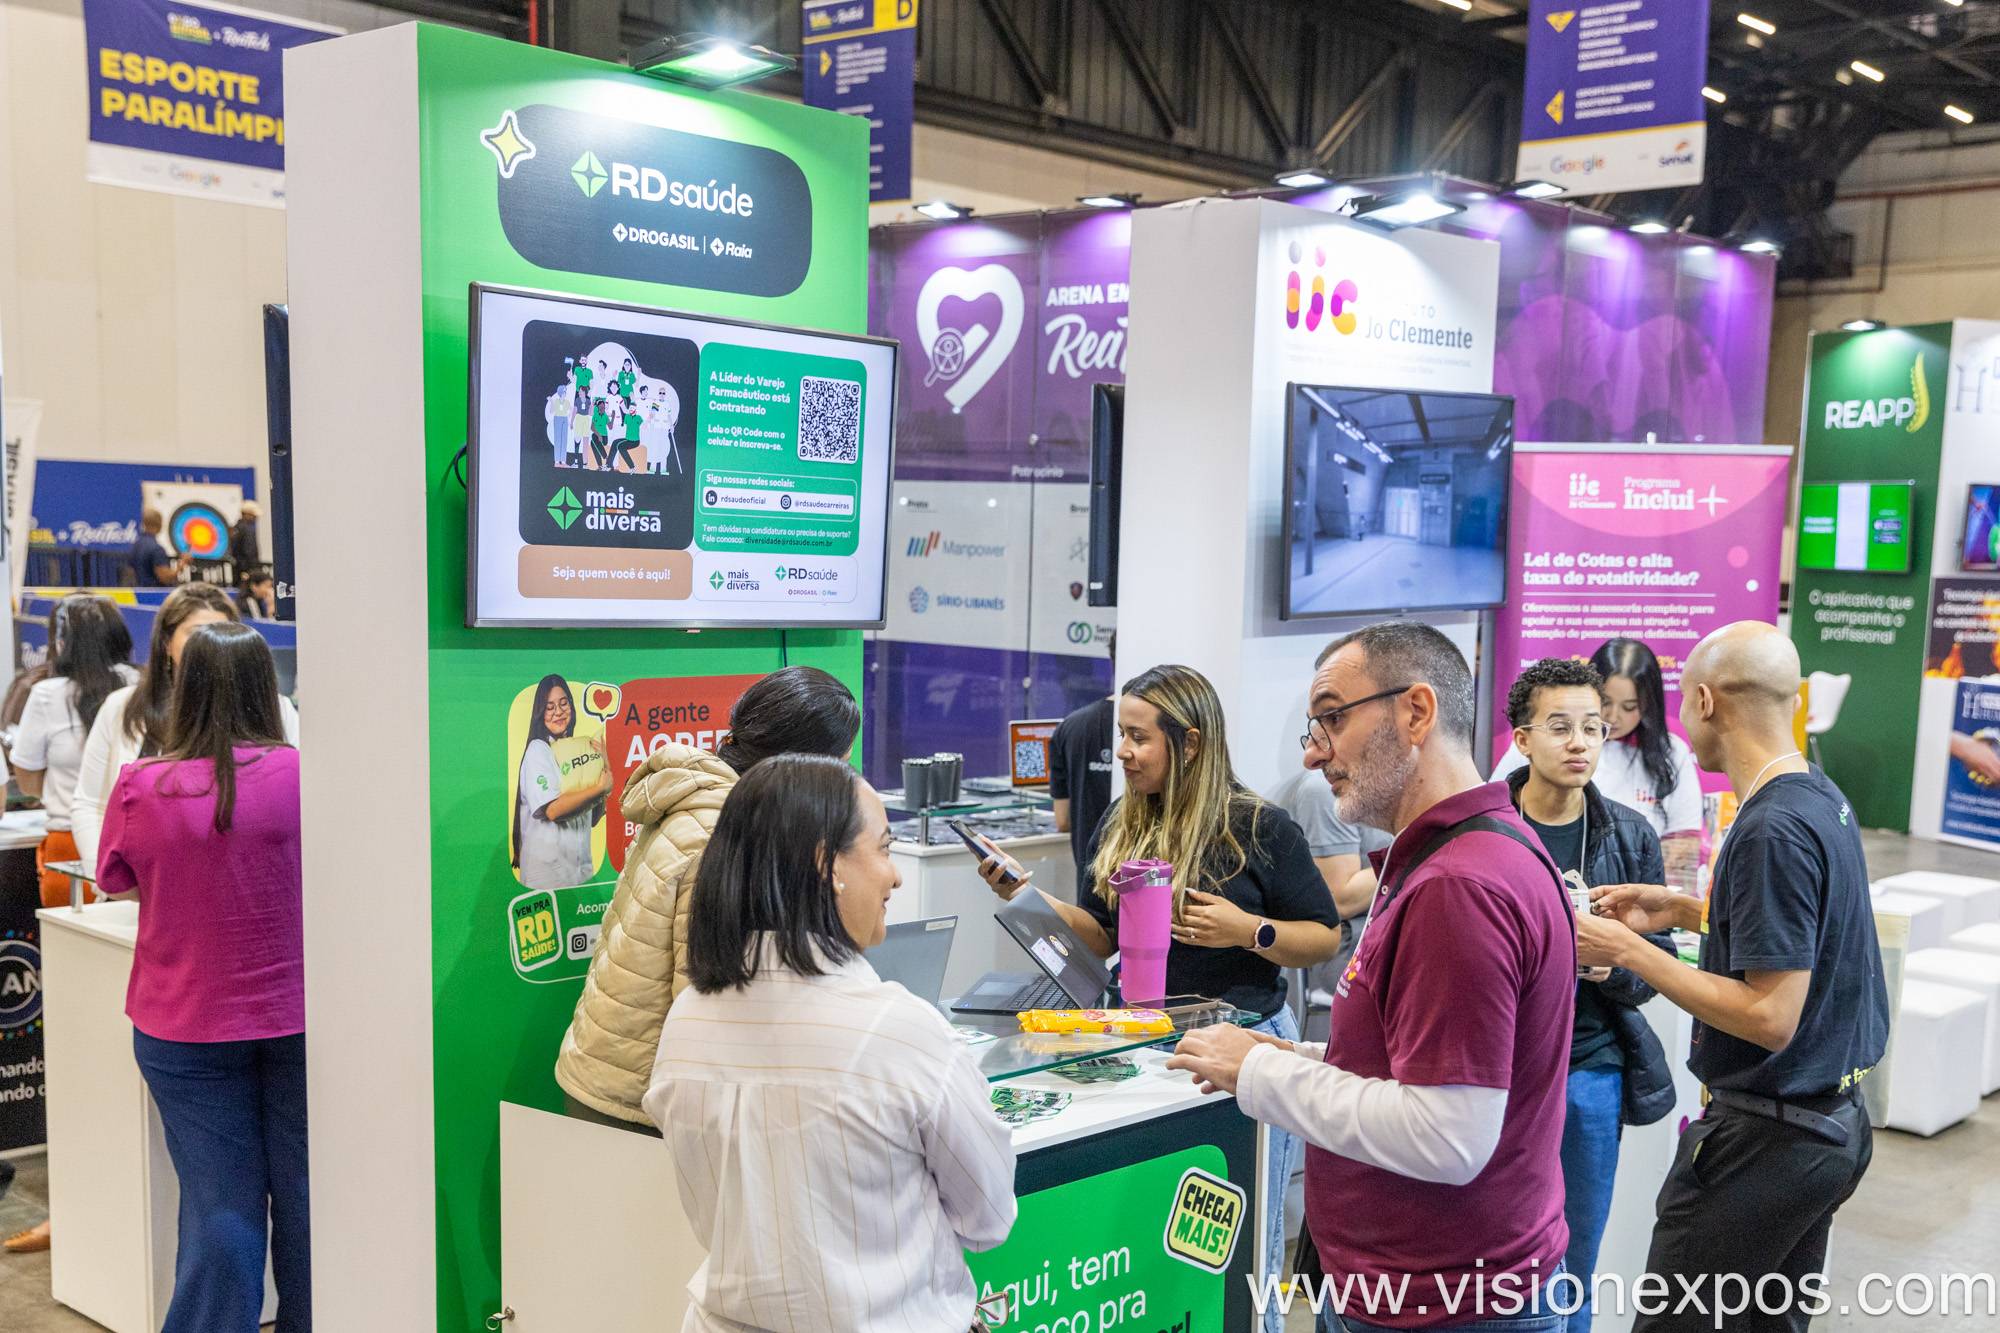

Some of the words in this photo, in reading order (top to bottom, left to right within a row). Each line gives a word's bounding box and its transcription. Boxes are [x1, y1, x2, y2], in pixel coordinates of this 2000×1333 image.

[897, 0, 913, 22] D
[100, 47, 260, 104] ESPORTE
[101, 88, 285, 146] PARALÍMPI
[628, 226, 700, 251] DROGASIL
[725, 241, 753, 260] Raia
[1045, 284, 1104, 307] ARENA
[1389, 318, 1473, 350] Clemente
[709, 371, 718, 382] A
[743, 375, 756, 385] do
[757, 376, 785, 391] Varejo
[709, 385, 771, 402] Farmacêutico
[709, 400, 767, 415] Contratando
[1824, 397, 1916, 430] REAPP
[724, 426, 730, 434] o
[731, 426, 743, 437] QR
[743, 426, 763, 437] Code
[763, 429, 780, 439] com
[707, 436, 734, 448] celular
[739, 439, 784, 451] inscreva-se.
[706, 473, 722, 485] Siga
[722, 475, 748, 485] nossas
[749, 476, 769, 486] redes
[769, 477, 796, 488] sociais:
[1623, 476, 1681, 490] Programa
[586, 486, 635, 510] mais
[720, 495, 767, 505] rdsaudeoficial
[1622, 488, 1695, 511] Inclui
[585, 508, 662, 533] diversa
[702, 523, 718, 533] Tem
[718, 525, 743, 534] dúvidas
[743, 527, 751, 535] na
[751, 527, 788, 536] candidatura
[787, 529, 796, 537] ou
[796, 529, 817, 539] precisa
[817, 529, 827, 538] de
[702, 535, 715, 543] Fale
[1524, 552, 1551, 568] Lei
[1552, 552, 1574, 567] de
[1577, 552, 1625, 568] Cotas
[1626, 556, 1638, 568] e
[1640, 553, 1674, 568] alta
[552, 566, 577, 580] Seja
[577, 568, 609, 582] quem
[610, 566, 637, 580] você
[637, 566, 645, 580] é
[646, 567, 672, 582] aqui!
[727, 568, 749, 580] mais
[1523, 571, 1561, 585] taxa
[1563, 571, 1585, 586] de
[1586, 571, 1700, 586] rotatividade?
[726, 580, 760, 591] diversa
[1886, 595, 1914, 612] que
[624, 703, 641, 725] A
[648, 702, 710, 731] gente
[571, 753, 601, 769] RDsa
[534, 898, 550, 911] PRA
[576, 903, 608, 915] Acom
[517, 910, 554, 949] RD
[521, 939, 557, 962] SAÚDE!
[1182, 1183, 1236, 1228] CHEGA
[1174, 1212, 1230, 1257] MAIS!
[1068, 1246, 1131, 1291] tem
[1100, 1289, 1147, 1330] pra
